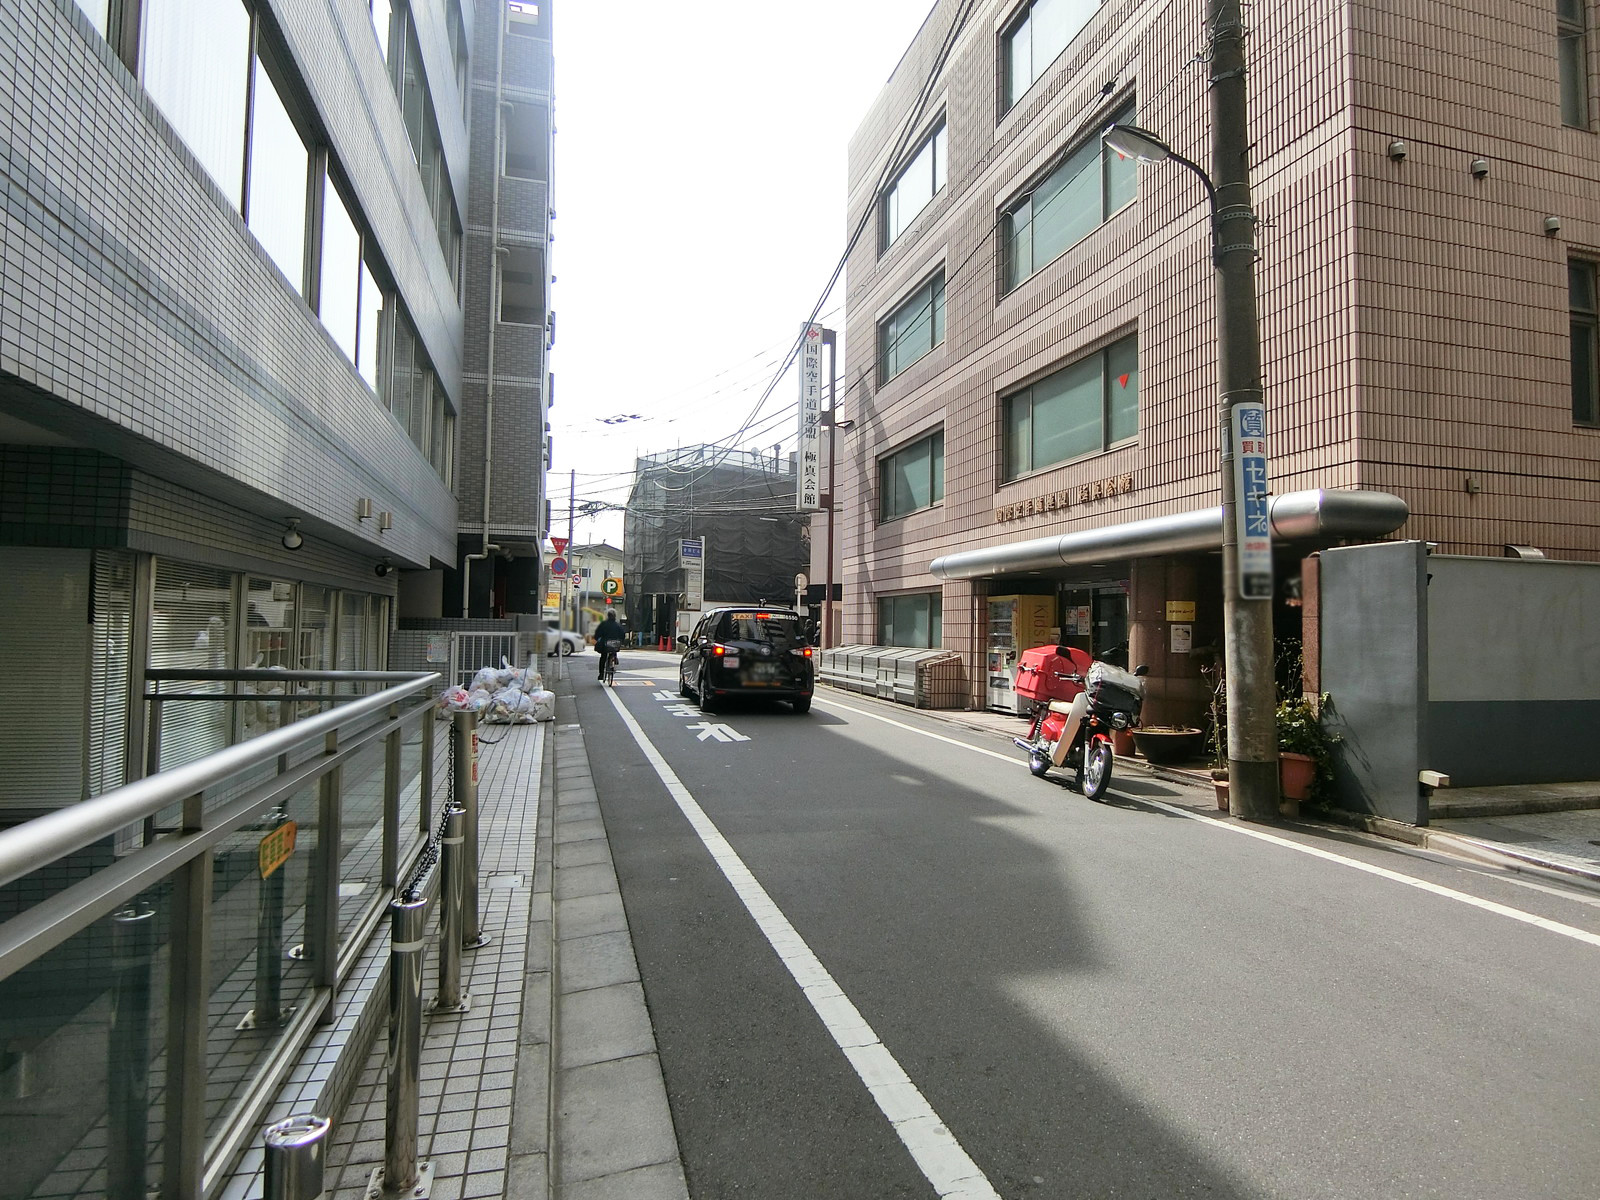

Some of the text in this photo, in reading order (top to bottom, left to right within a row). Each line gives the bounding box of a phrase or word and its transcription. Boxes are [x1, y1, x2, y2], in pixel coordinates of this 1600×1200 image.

[804, 343, 818, 504] 国際空手道連盟 極真会館
[1246, 460, 1267, 533] セキネ
[1033, 605, 1048, 637] Kids
